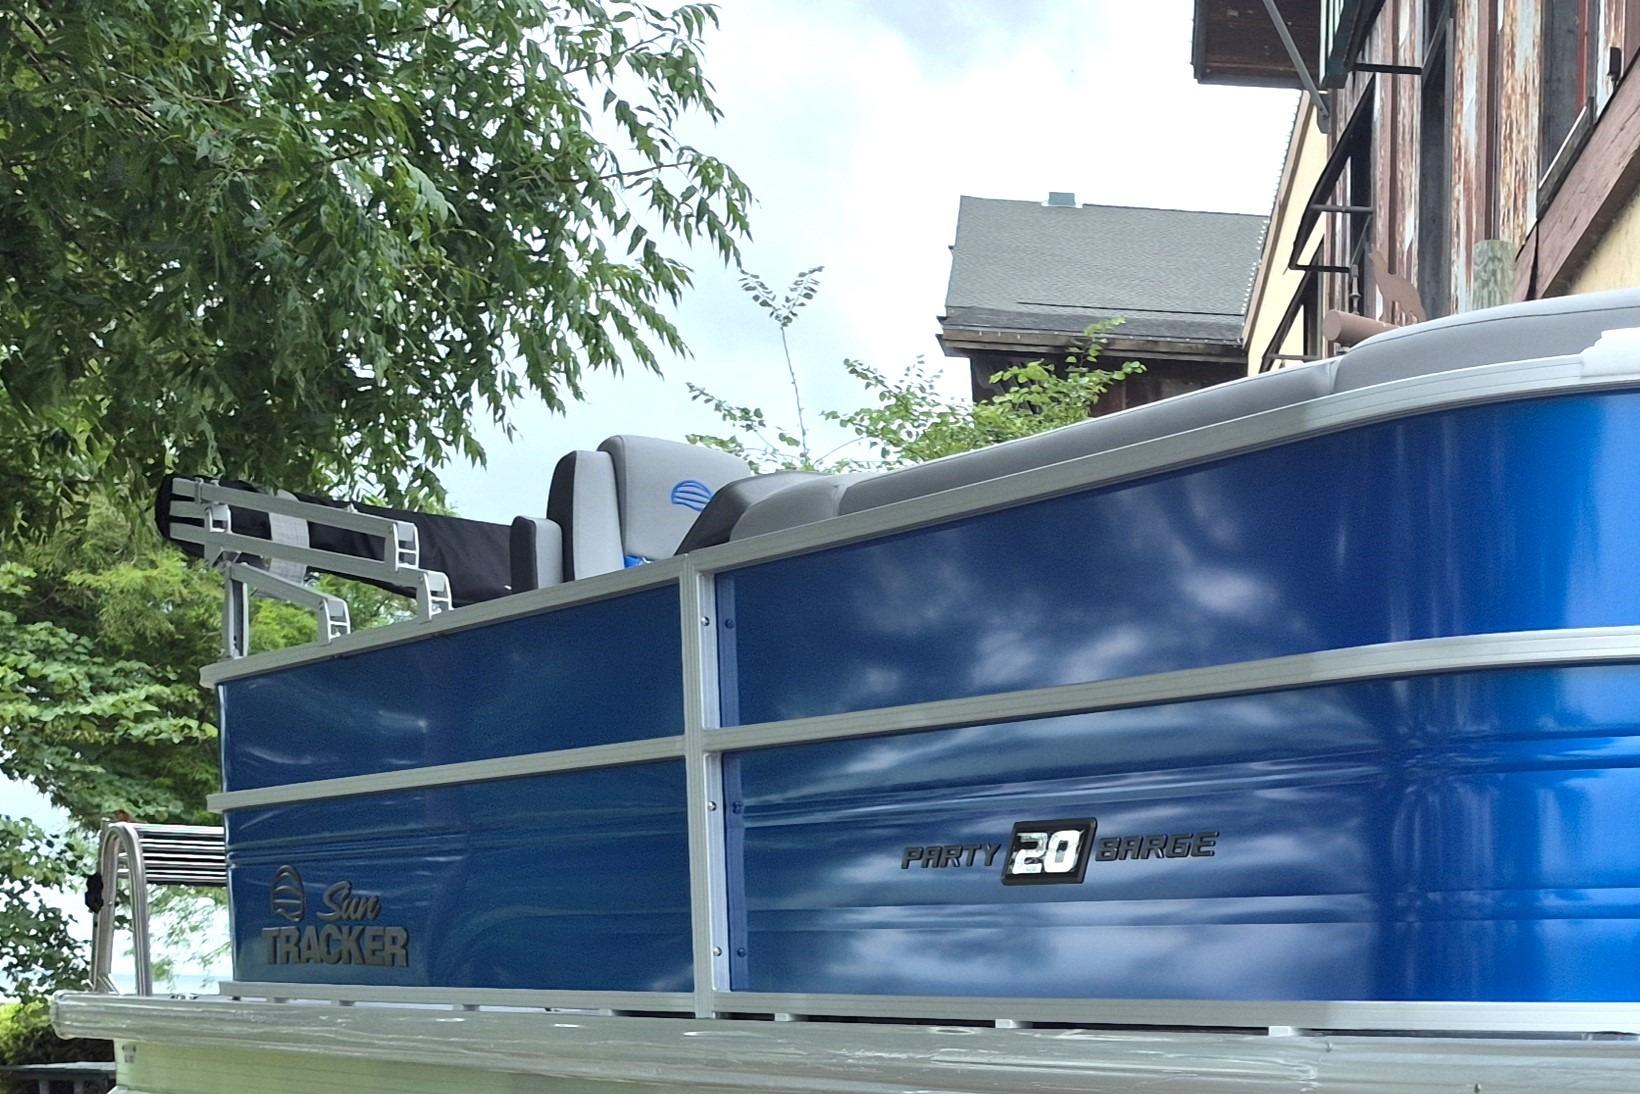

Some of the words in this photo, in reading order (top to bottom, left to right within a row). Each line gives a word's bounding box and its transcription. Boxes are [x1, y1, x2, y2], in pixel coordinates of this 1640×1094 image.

[901, 843, 1001, 870] PARTY
[1010, 829, 1084, 875] 20
[1094, 831, 1220, 862] BARGE
[316, 880, 383, 922] Sun
[261, 923, 410, 968] TRACKER
